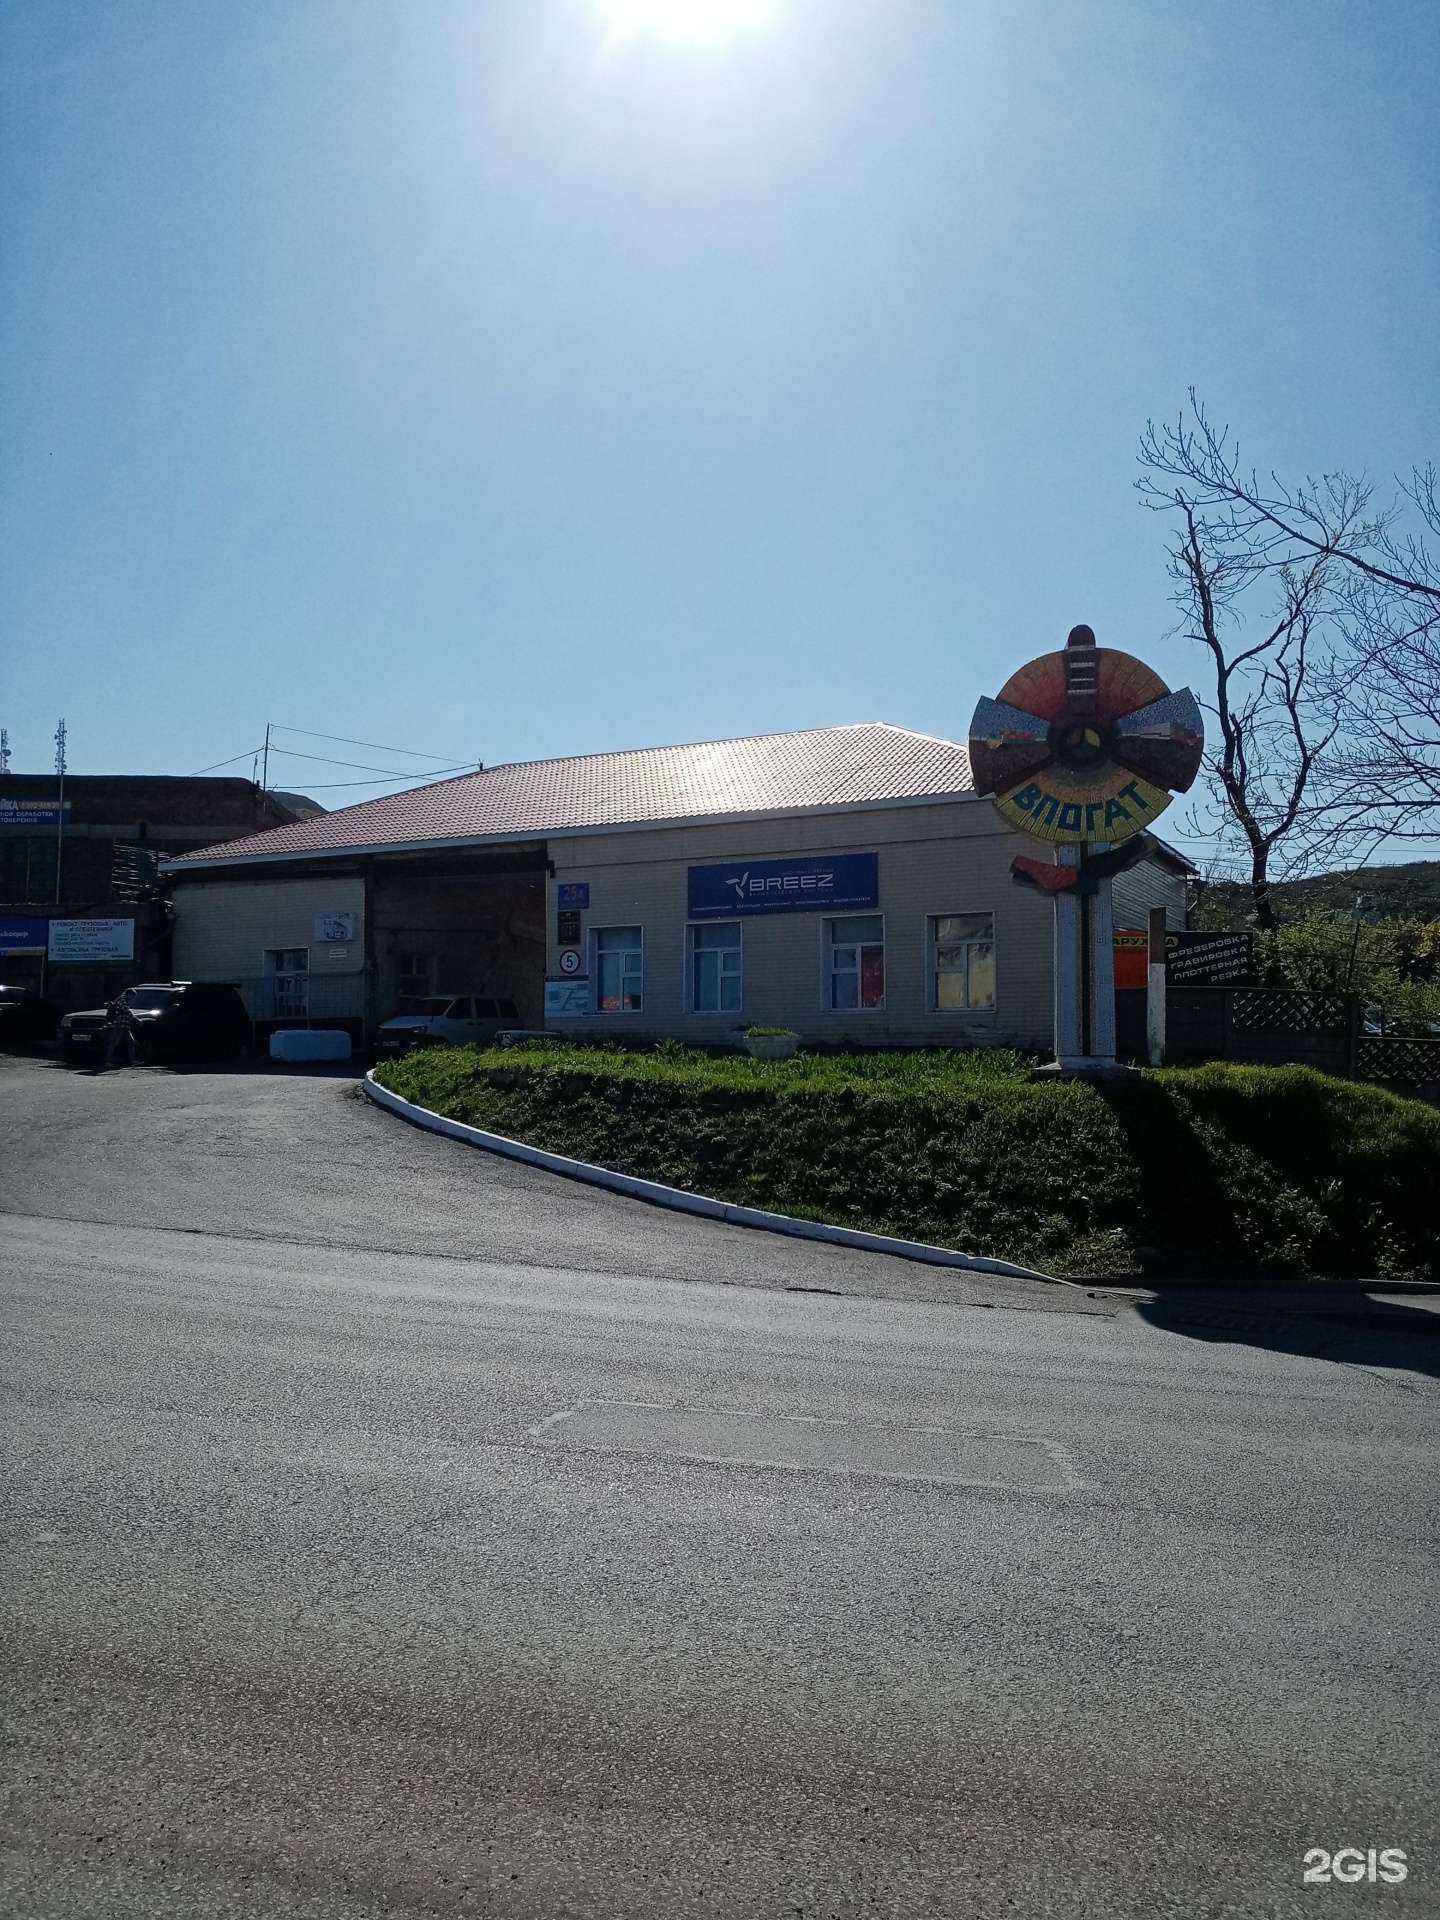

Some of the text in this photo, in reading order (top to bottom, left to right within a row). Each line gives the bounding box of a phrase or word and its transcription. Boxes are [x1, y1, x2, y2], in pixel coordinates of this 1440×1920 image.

[749, 873, 834, 892] BREEZ
[1168, 934, 1249, 959] ФРЕЗЕРОВКА
[564, 954, 574, 969] 5
[1170, 946, 1247, 969] ГРАВИРОВКА
[1174, 957, 1248, 980] ПЛОТТЕРНАЯ
[1210, 968, 1248, 982] РЕЗКА
